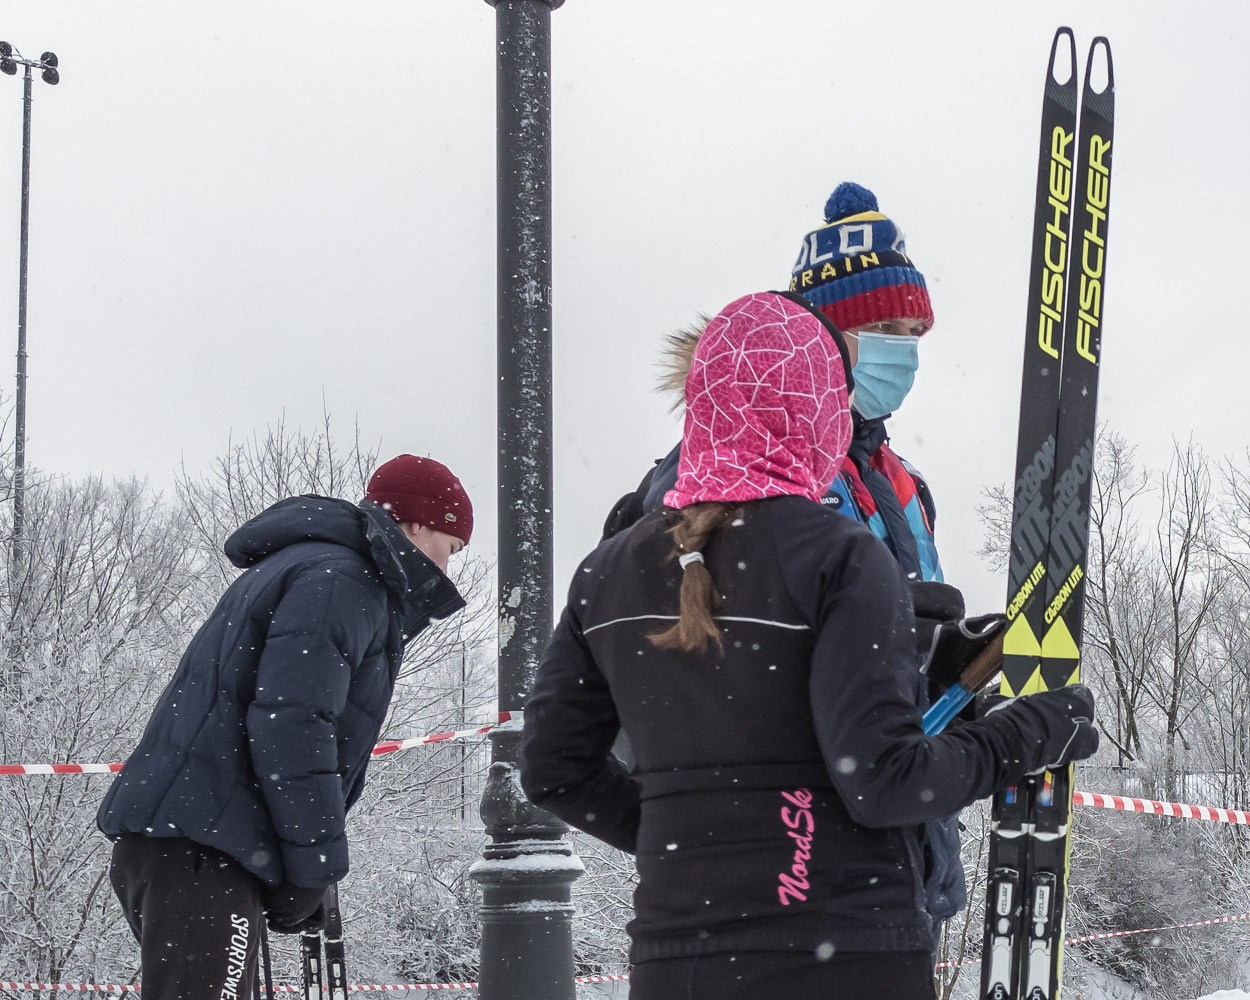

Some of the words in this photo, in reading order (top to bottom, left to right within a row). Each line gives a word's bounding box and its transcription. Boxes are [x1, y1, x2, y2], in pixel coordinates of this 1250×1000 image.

[1038, 126, 1074, 360] FISCHER
[1075, 134, 1111, 364] FISCHER
[1006, 577, 1035, 621] CARBON
[1029, 561, 1047, 590] LITE
[1044, 581, 1073, 625] CARBON
[1067, 564, 1084, 592] LITE
